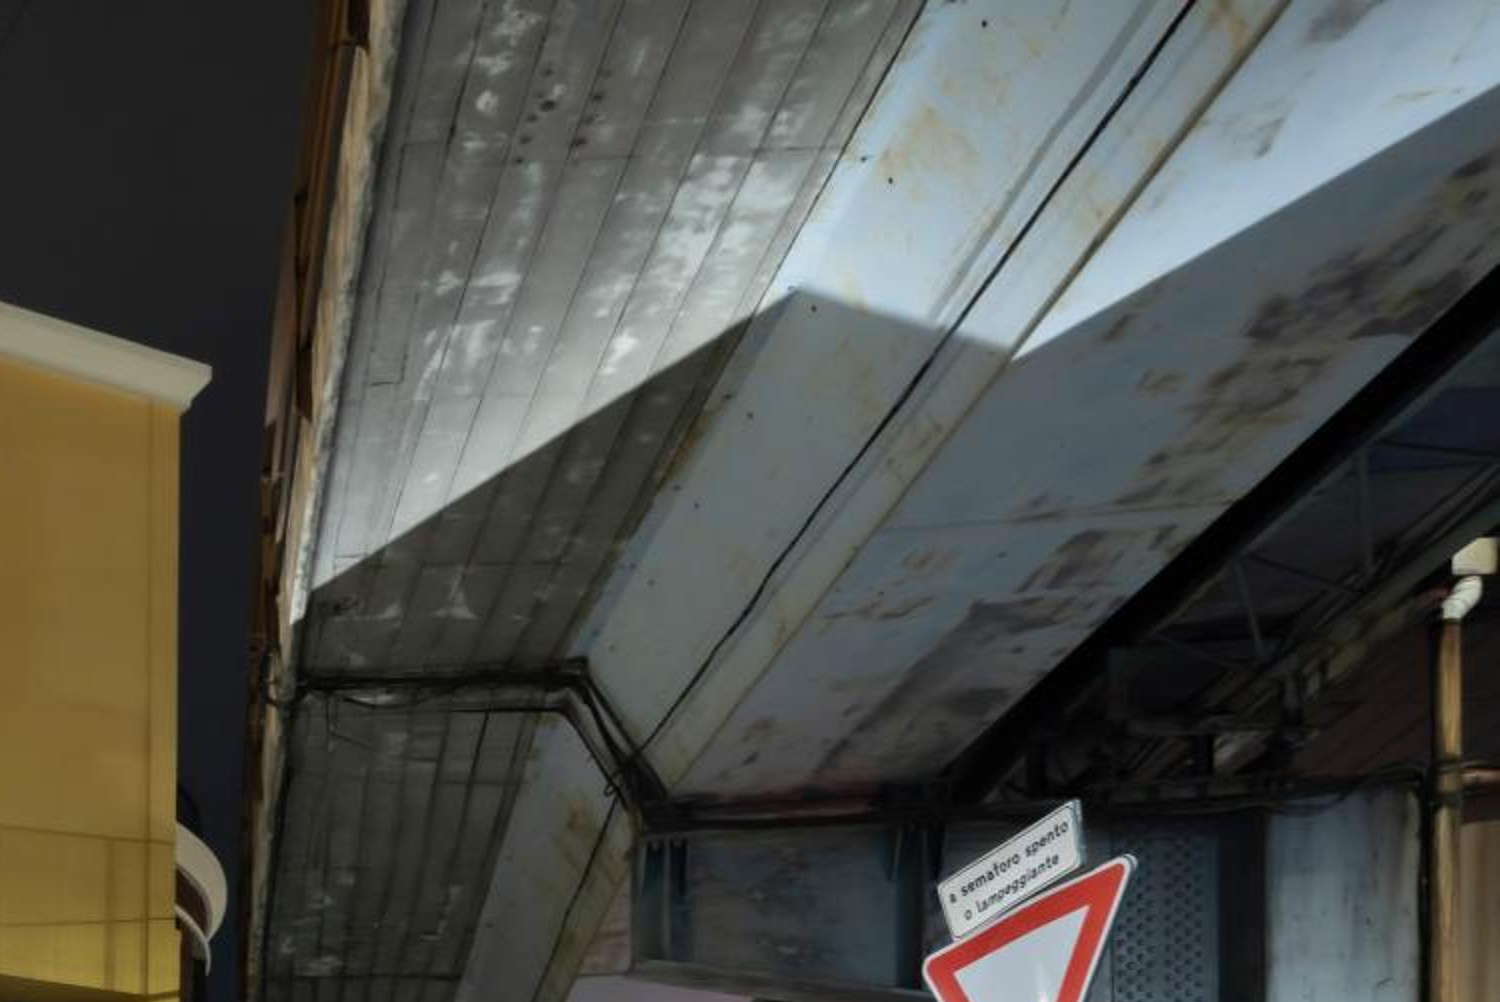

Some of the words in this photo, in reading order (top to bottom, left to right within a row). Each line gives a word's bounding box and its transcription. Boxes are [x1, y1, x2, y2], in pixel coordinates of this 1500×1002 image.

[961, 853, 1020, 897] semaforo
[1025, 821, 1069, 857] spento
[964, 909, 972, 921] o
[976, 854, 1059, 913] lampeggiante
